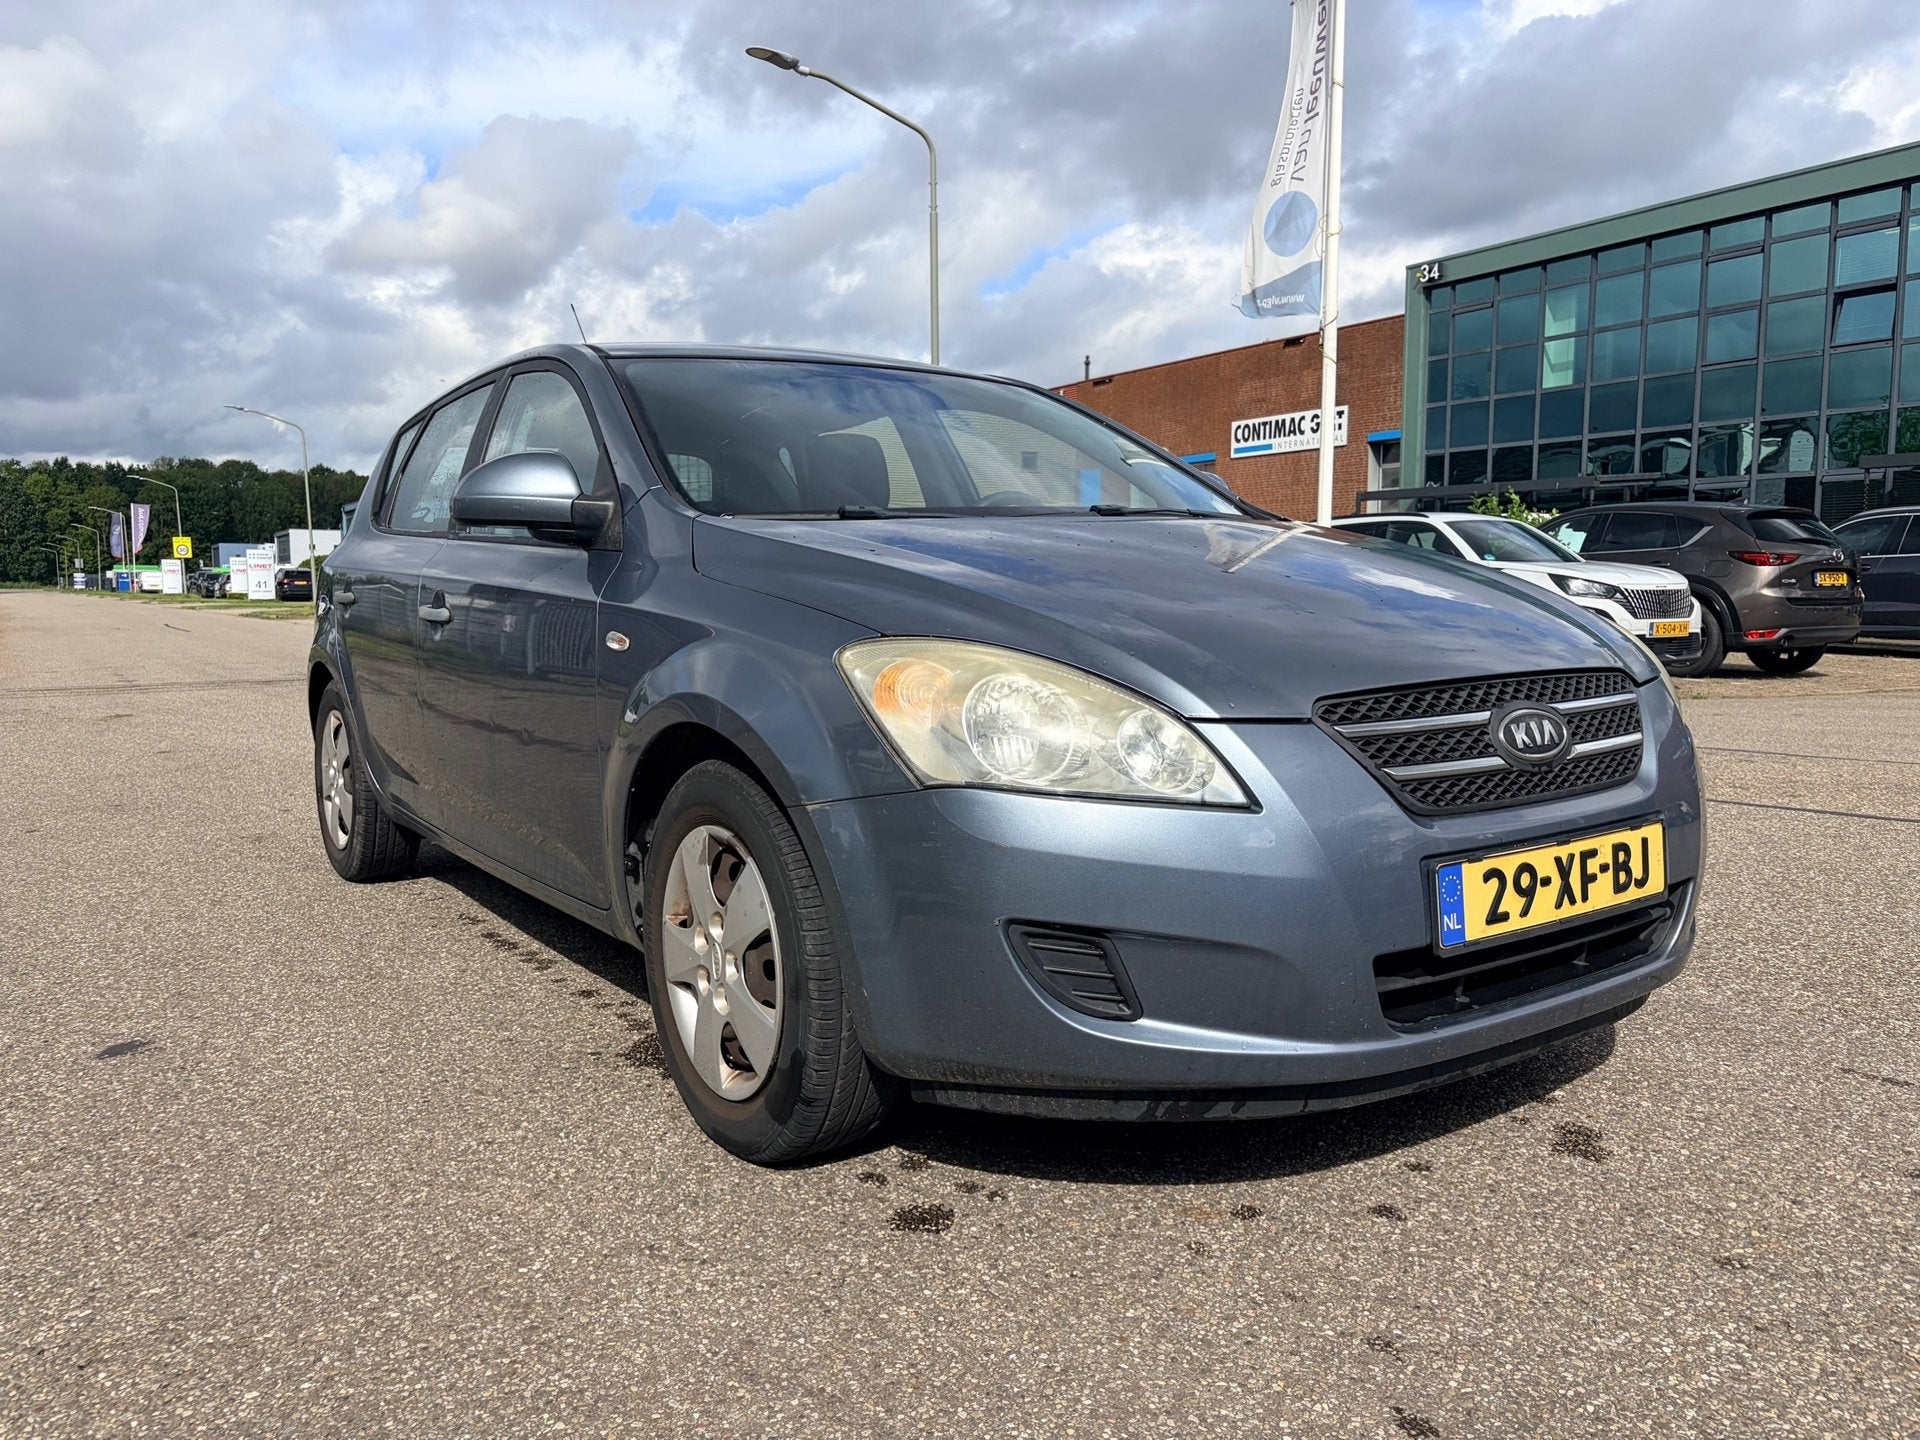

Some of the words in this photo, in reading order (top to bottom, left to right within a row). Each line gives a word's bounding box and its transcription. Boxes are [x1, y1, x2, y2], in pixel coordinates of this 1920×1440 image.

[1420, 262, 1440, 282] 34
[1234, 415, 1306, 444] CONTIMAC
[1310, 410, 1345, 434] GT
[1274, 434, 1345, 450] INTERNATIAL
[256, 580, 267, 589] 41
[1654, 622, 1689, 635] X-504-XH
[1509, 718, 1561, 750] KIA
[1482, 836, 1650, 926] 29-XF-BJ
[1442, 913, 1462, 932] NL
